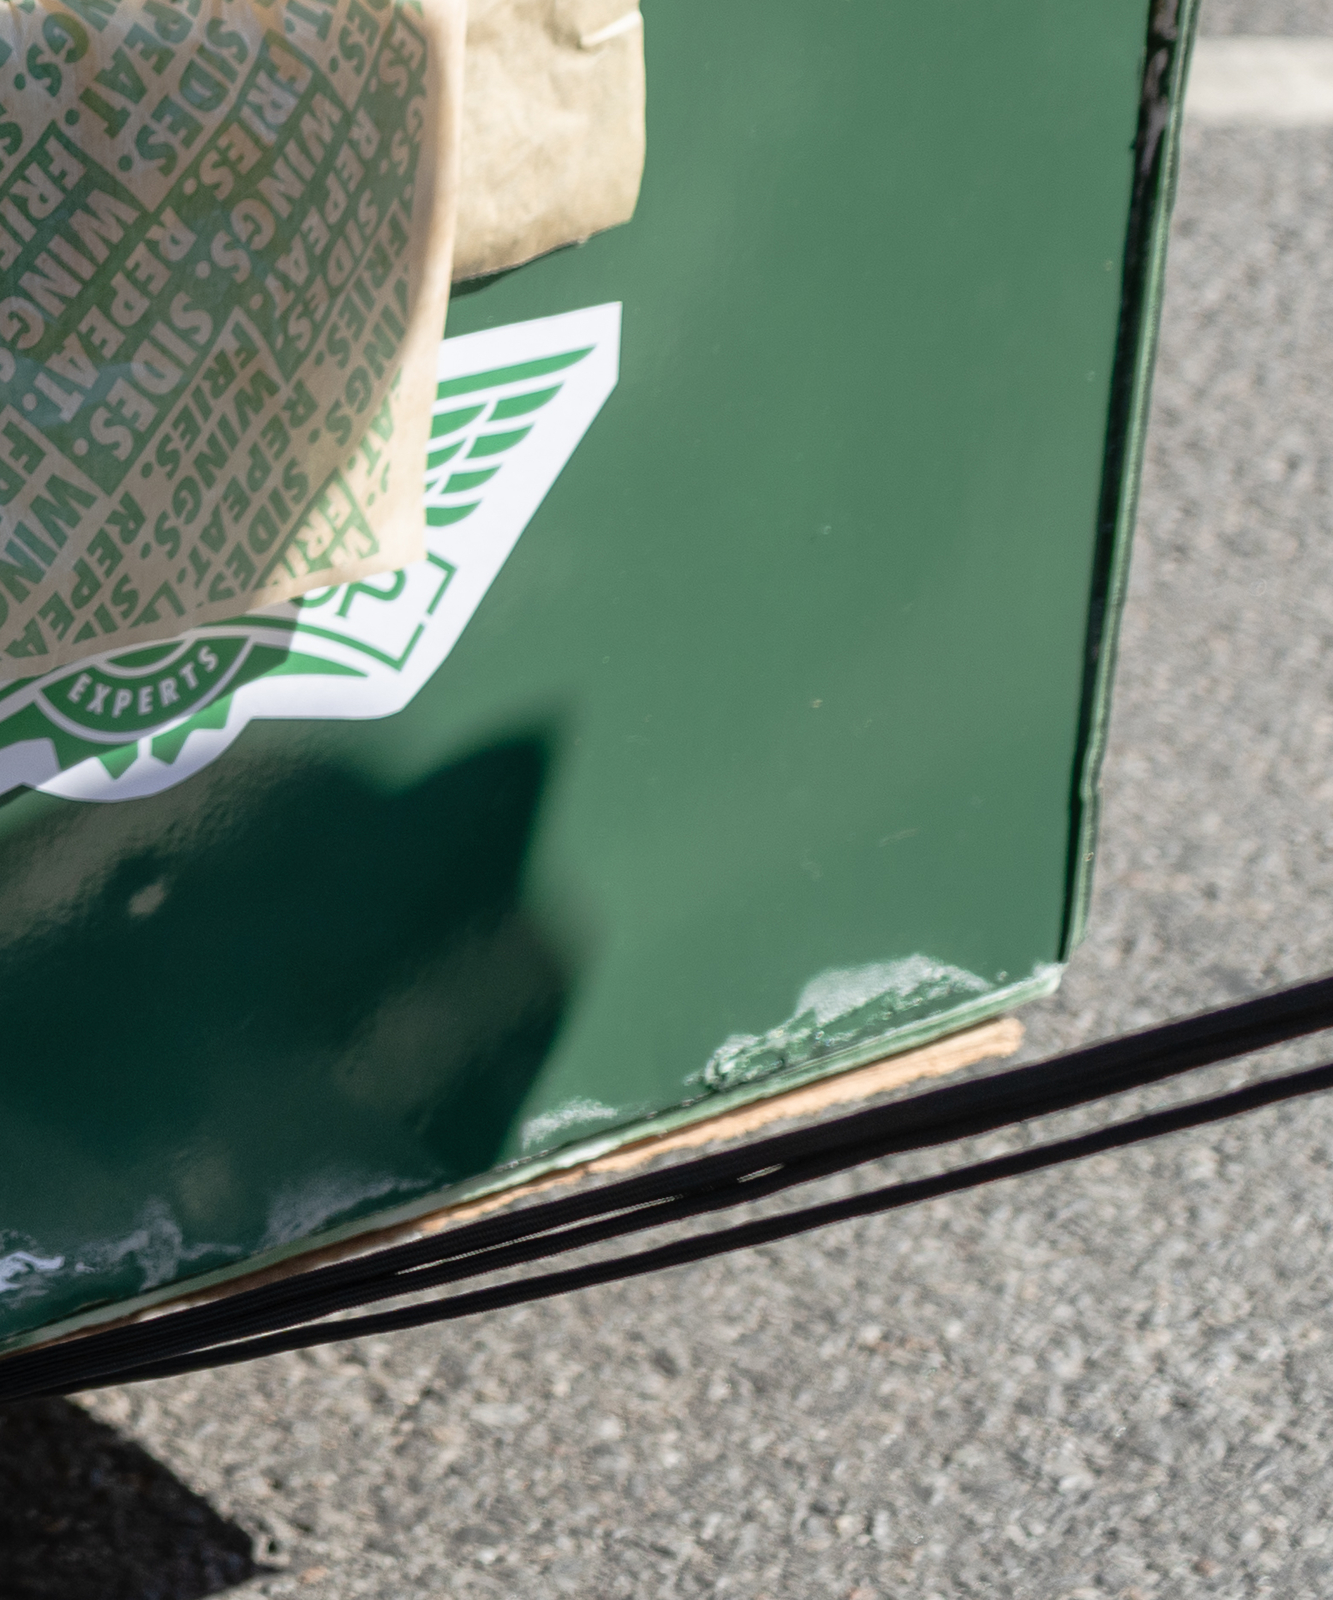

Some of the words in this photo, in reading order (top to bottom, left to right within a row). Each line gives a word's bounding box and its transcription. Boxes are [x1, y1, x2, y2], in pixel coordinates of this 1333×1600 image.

[118, 14, 253, 178] SIDES.
[183, 42, 313, 201] FRIES.
[195, 93, 342, 284] WINGS.
[250, 107, 385, 318] REPEAT.
[273, 187, 382, 353] SIDES.
[22, 205, 198, 423] REPEAT.
[73, 289, 218, 463] SIDES.
[141, 319, 259, 481] FRIES.
[140, 366, 281, 561] WINGS.
[175, 378, 319, 589] REPEAT.
[66, 644, 219, 719] EXPERTS
